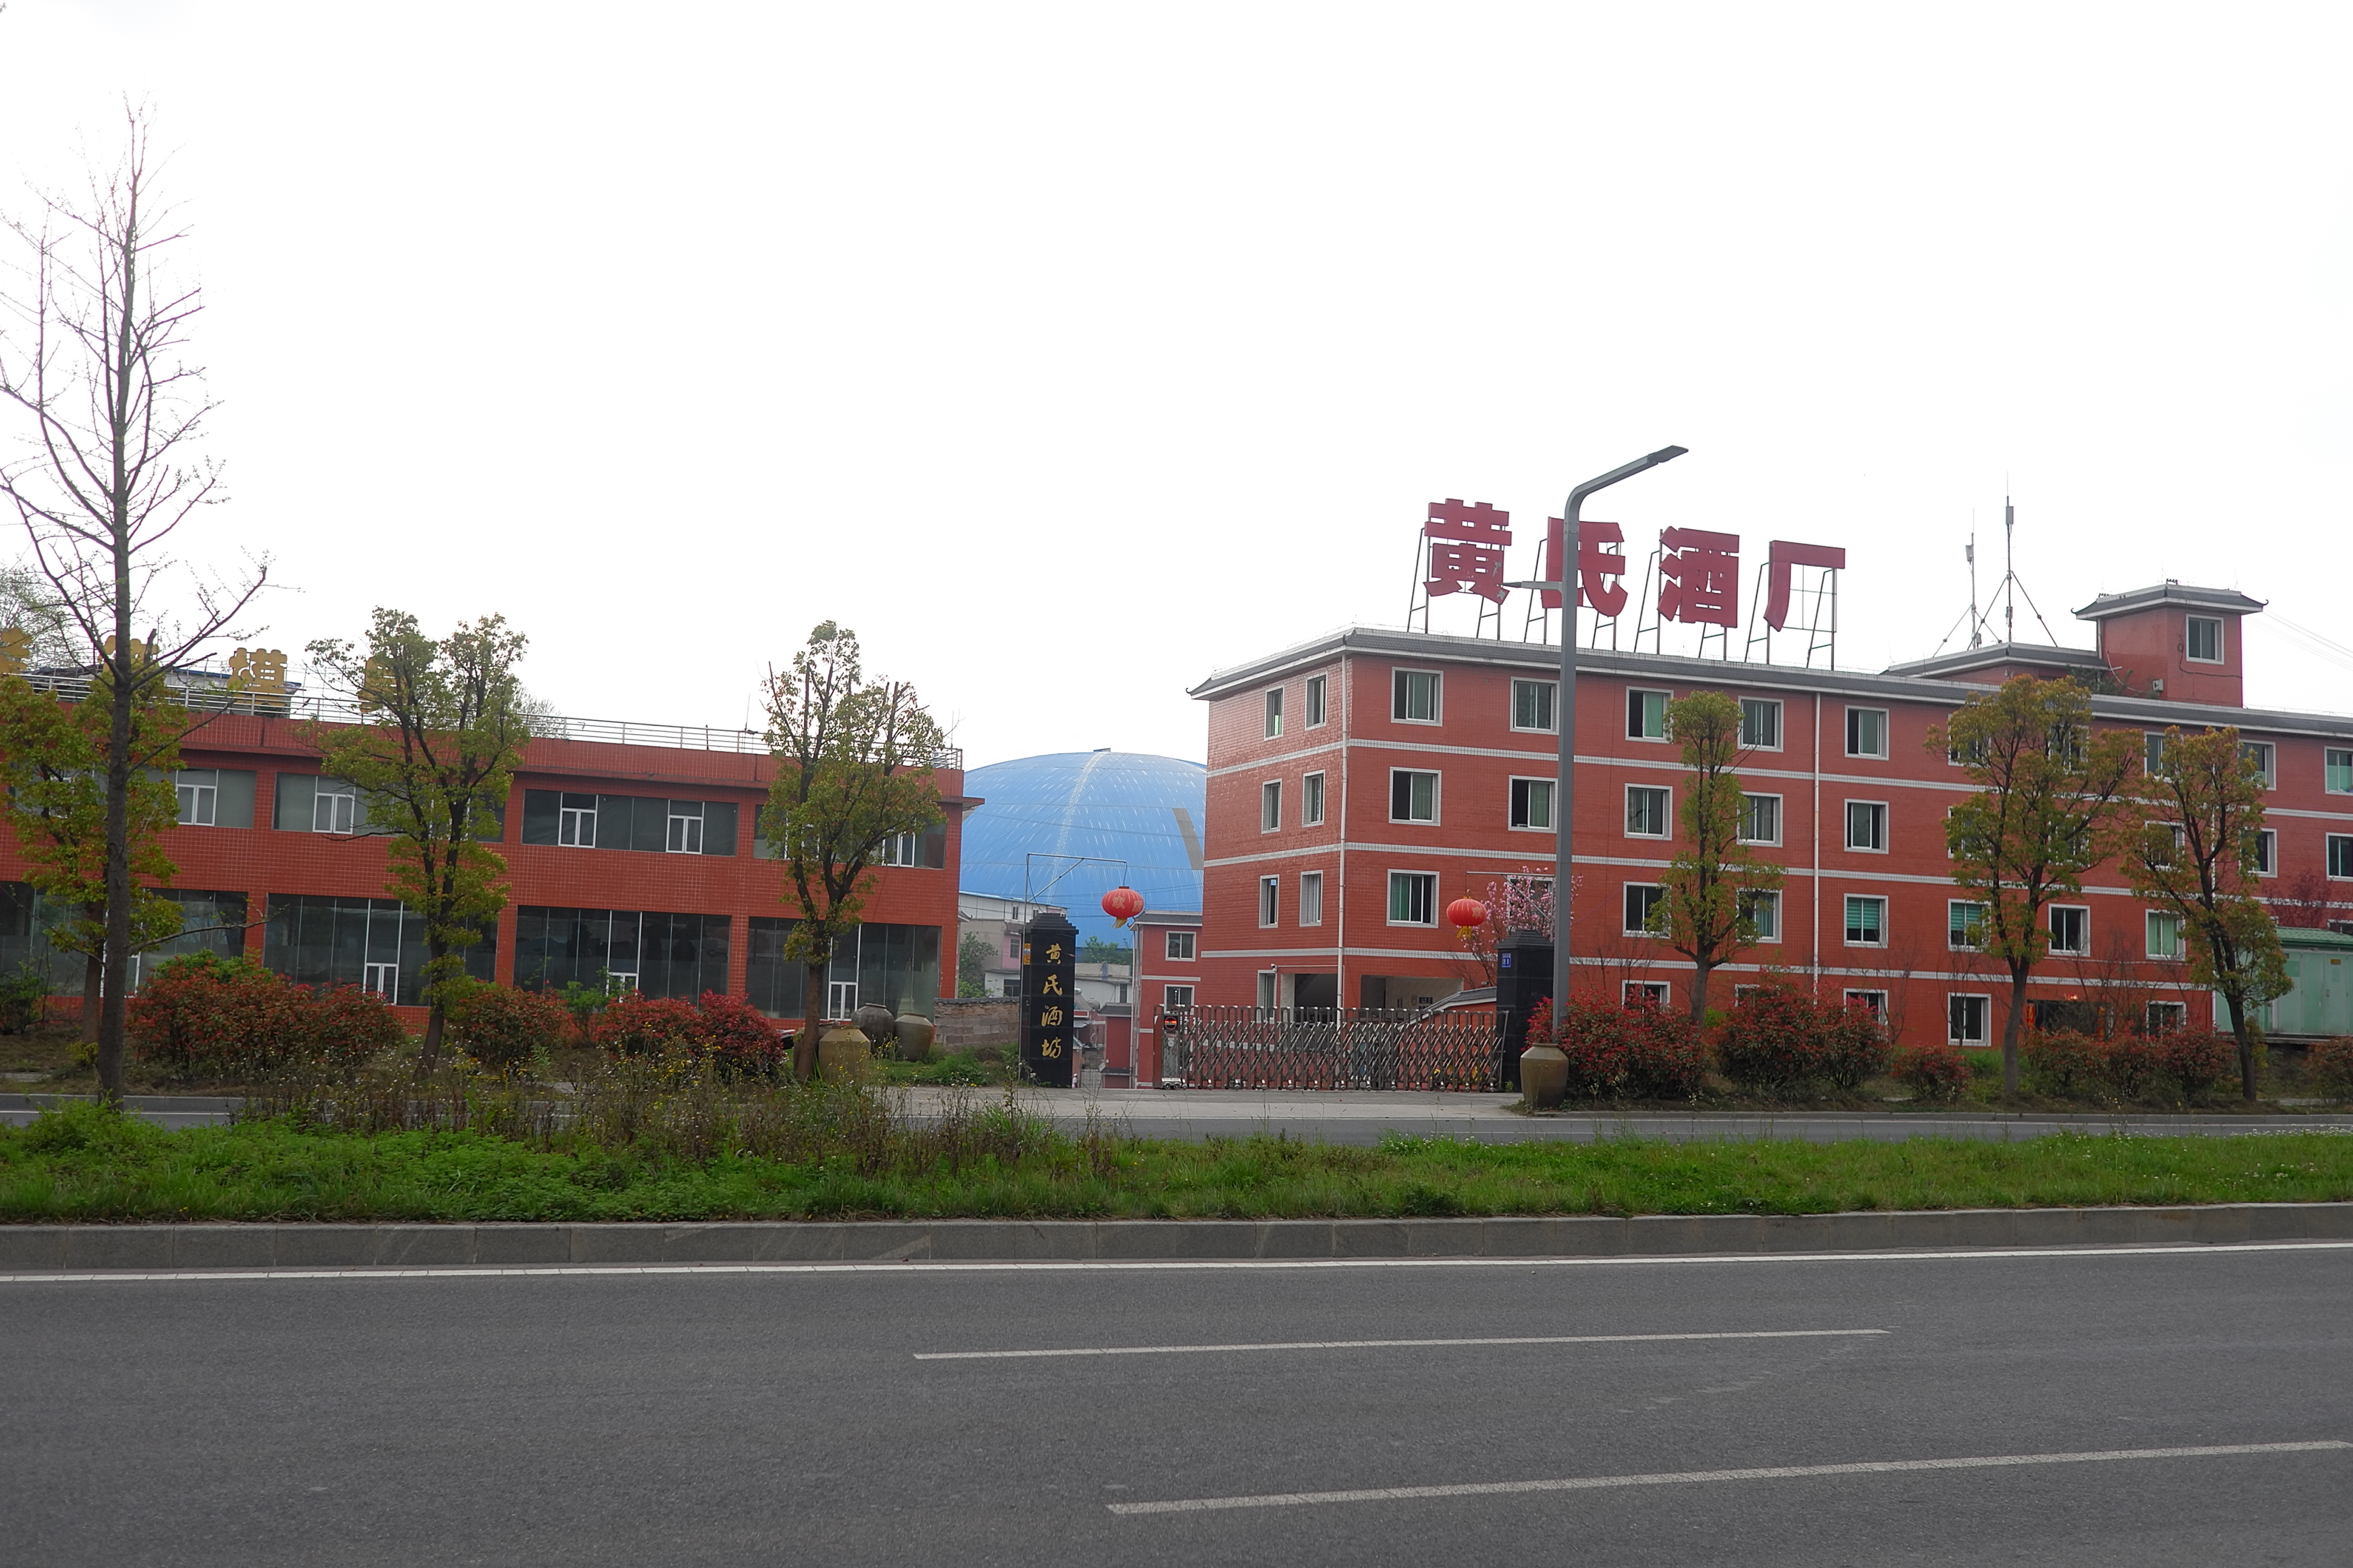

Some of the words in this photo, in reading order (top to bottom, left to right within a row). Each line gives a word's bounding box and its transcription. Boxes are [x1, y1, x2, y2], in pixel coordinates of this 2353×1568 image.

[1422, 498, 1846, 632] 黄氏酒厂
[1041, 943, 1063, 1058] 黄氏酒坊
